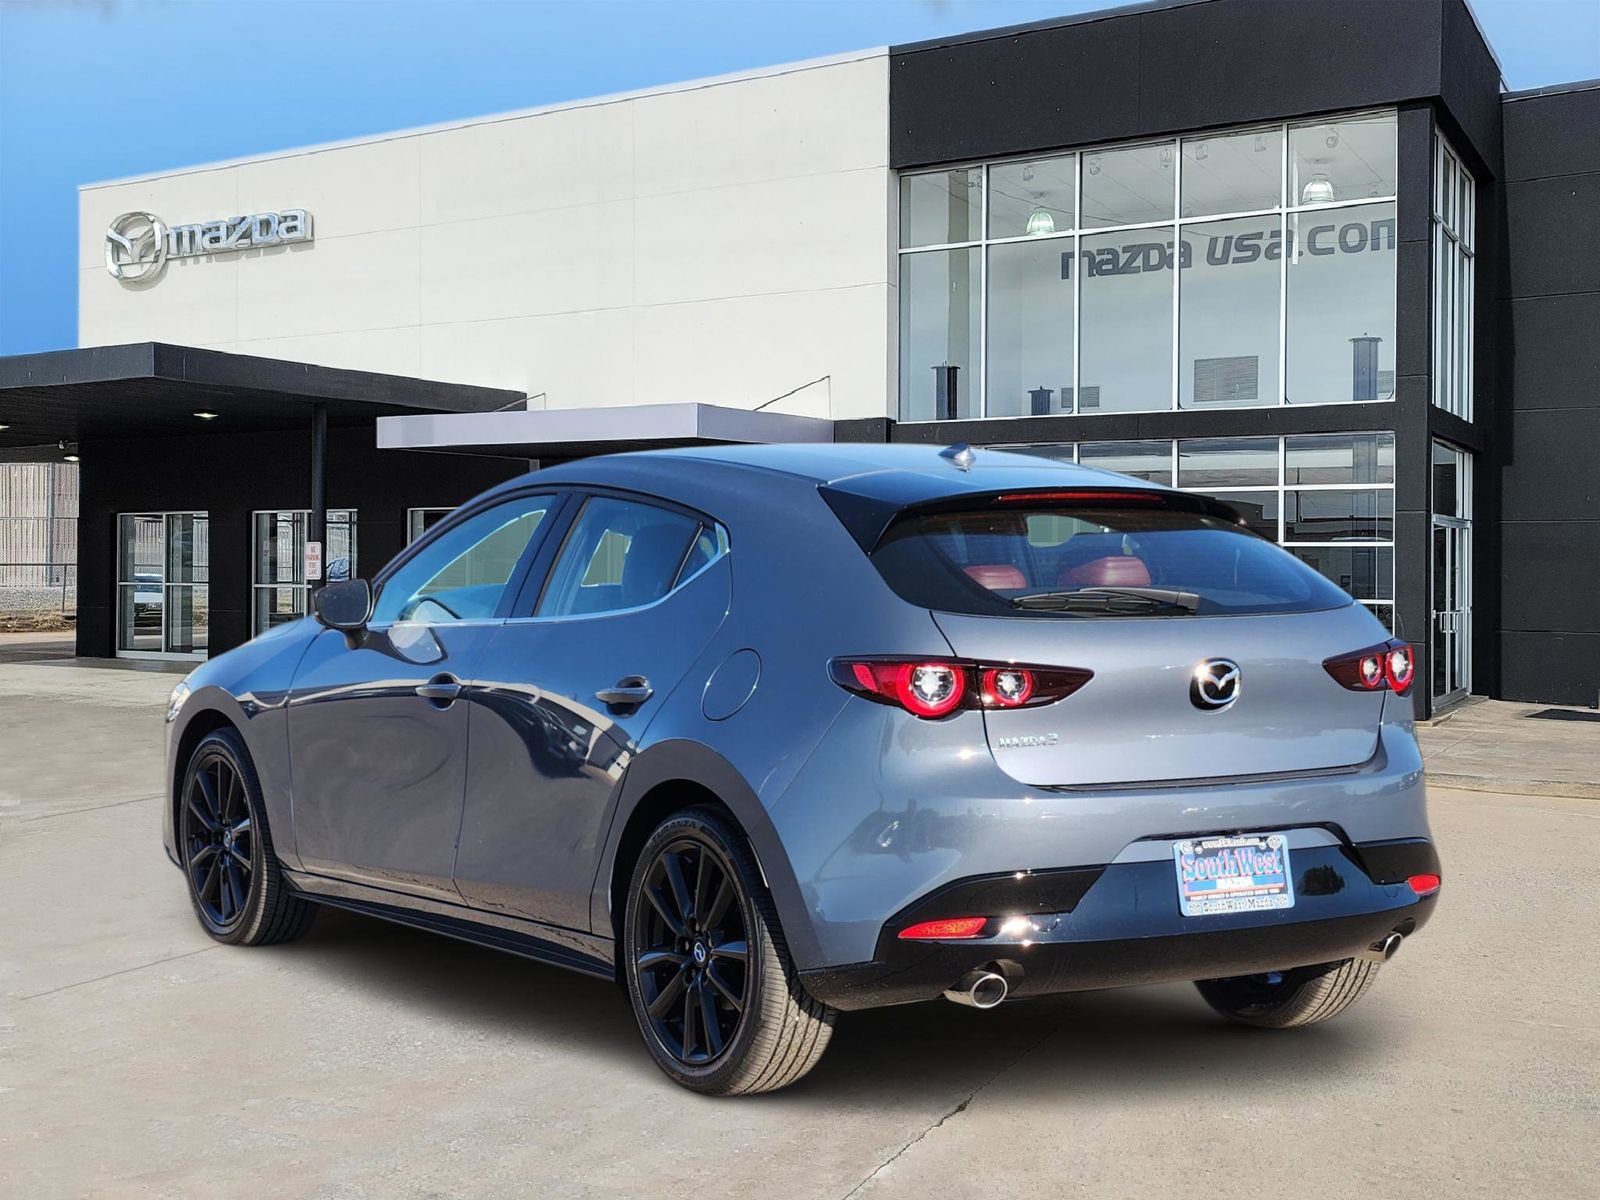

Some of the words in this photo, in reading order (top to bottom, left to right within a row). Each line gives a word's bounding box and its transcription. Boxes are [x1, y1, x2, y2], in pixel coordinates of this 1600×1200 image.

[166, 209, 312, 255] mazda
[1061, 240, 1193, 280] mazda
[1181, 847, 1284, 882] SouthWest
